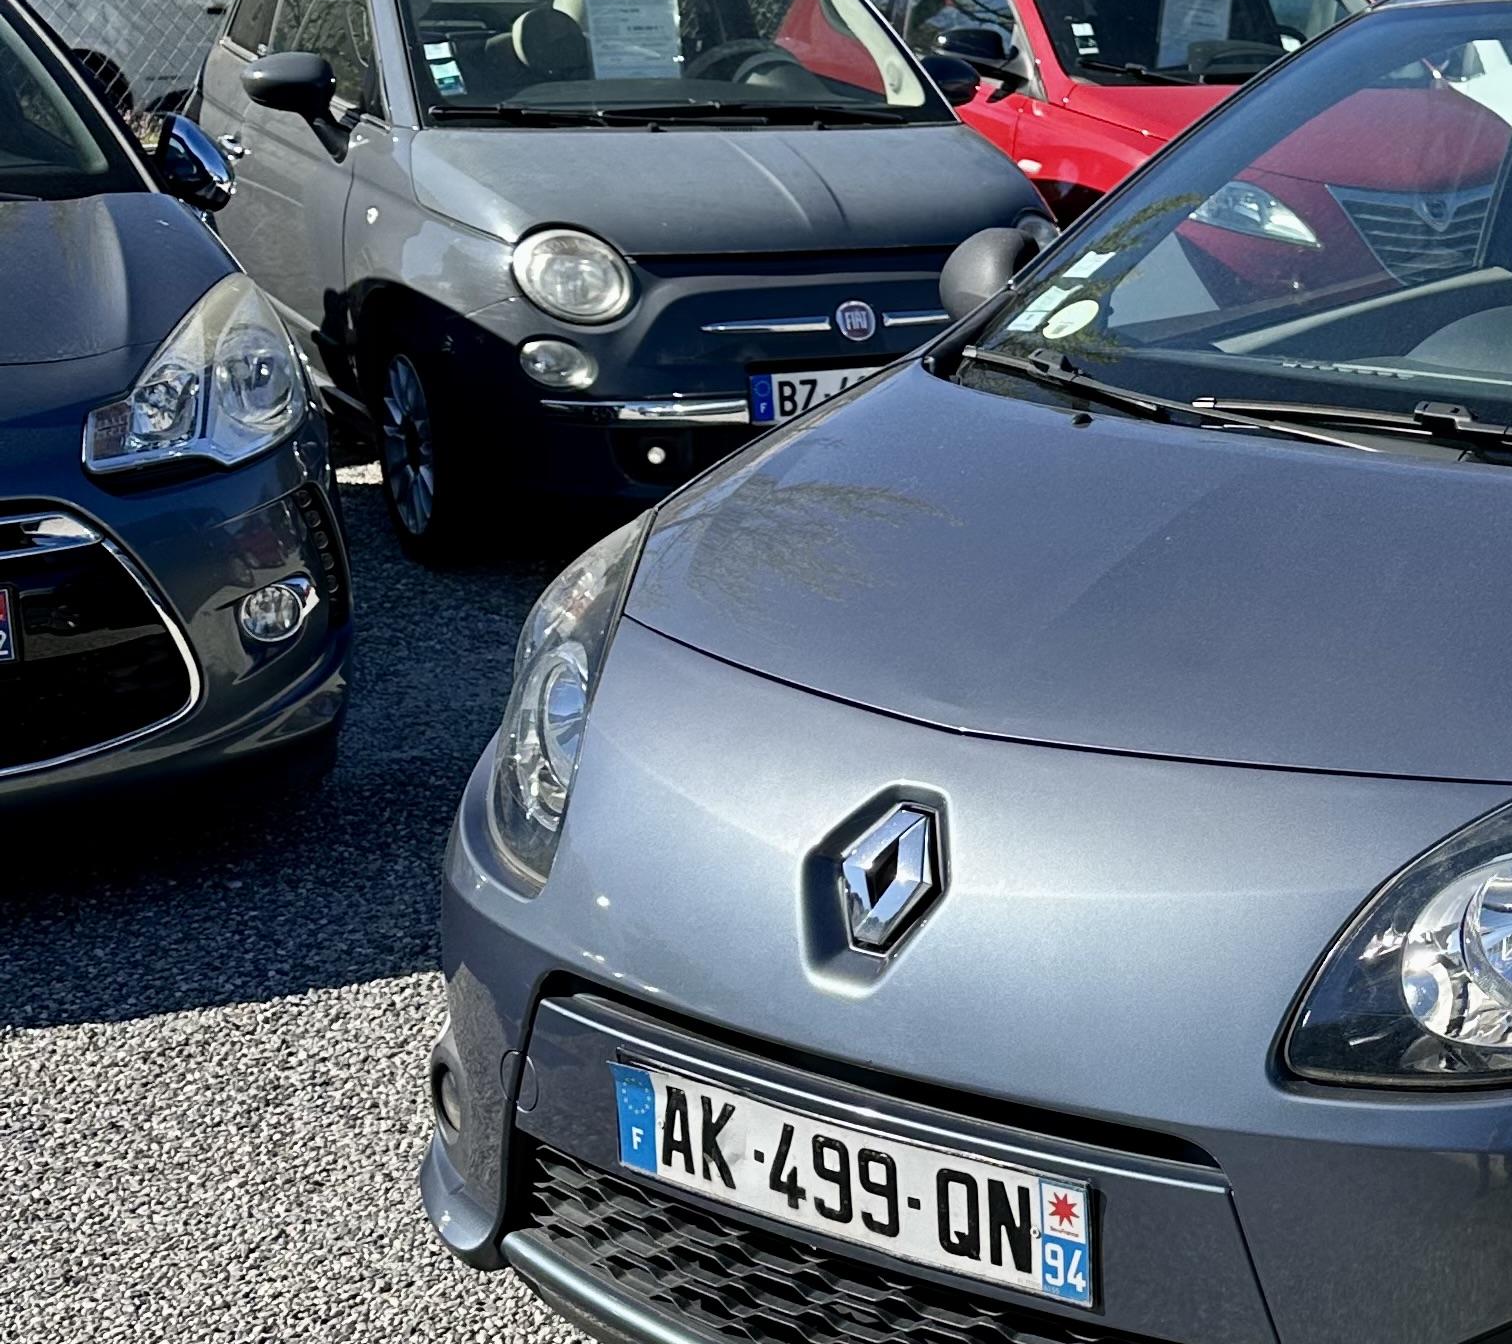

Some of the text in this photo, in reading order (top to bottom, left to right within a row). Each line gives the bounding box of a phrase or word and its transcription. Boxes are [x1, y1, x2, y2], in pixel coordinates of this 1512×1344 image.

[844, 310, 868, 331] FIAT
[631, 1126, 644, 1151] F
[661, 1087, 1033, 1275] AK-499-QN
[1044, 1242, 1087, 1294] 94
